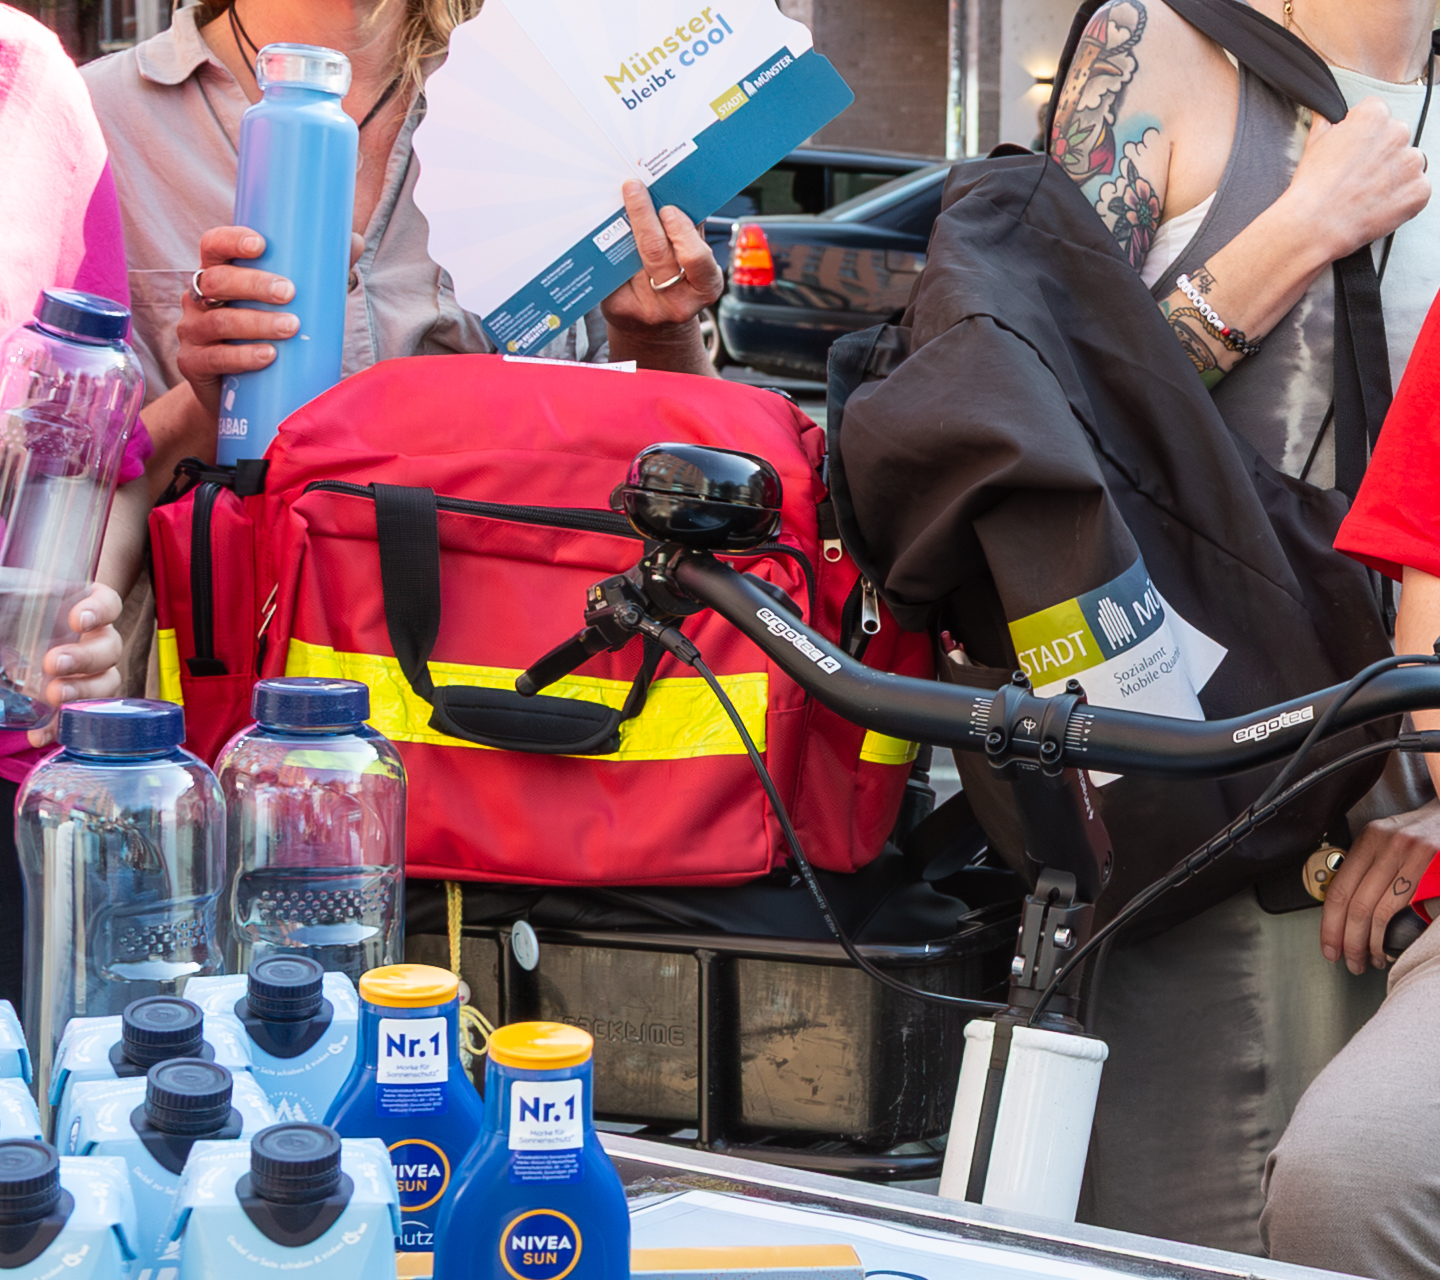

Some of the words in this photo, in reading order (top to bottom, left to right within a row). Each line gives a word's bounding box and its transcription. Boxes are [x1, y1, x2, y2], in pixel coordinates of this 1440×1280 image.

[604, 6, 714, 94] Münster
[621, 68, 676, 110] bleibt
[679, 13, 734, 66] cool
[717, 92, 745, 117] STADT
[753, 55, 793, 89] MÜNSTER
[756, 608, 826, 664] ergotec
[1017, 631, 1088, 676] STADT
[1113, 646, 1167, 684] Sozialamt
[1120, 668, 1160, 698] Mobile
[1233, 705, 1314, 743] ergotec
[511, 1235, 573, 1250] NIVEA
[522, 1252, 558, 1265] SUN
